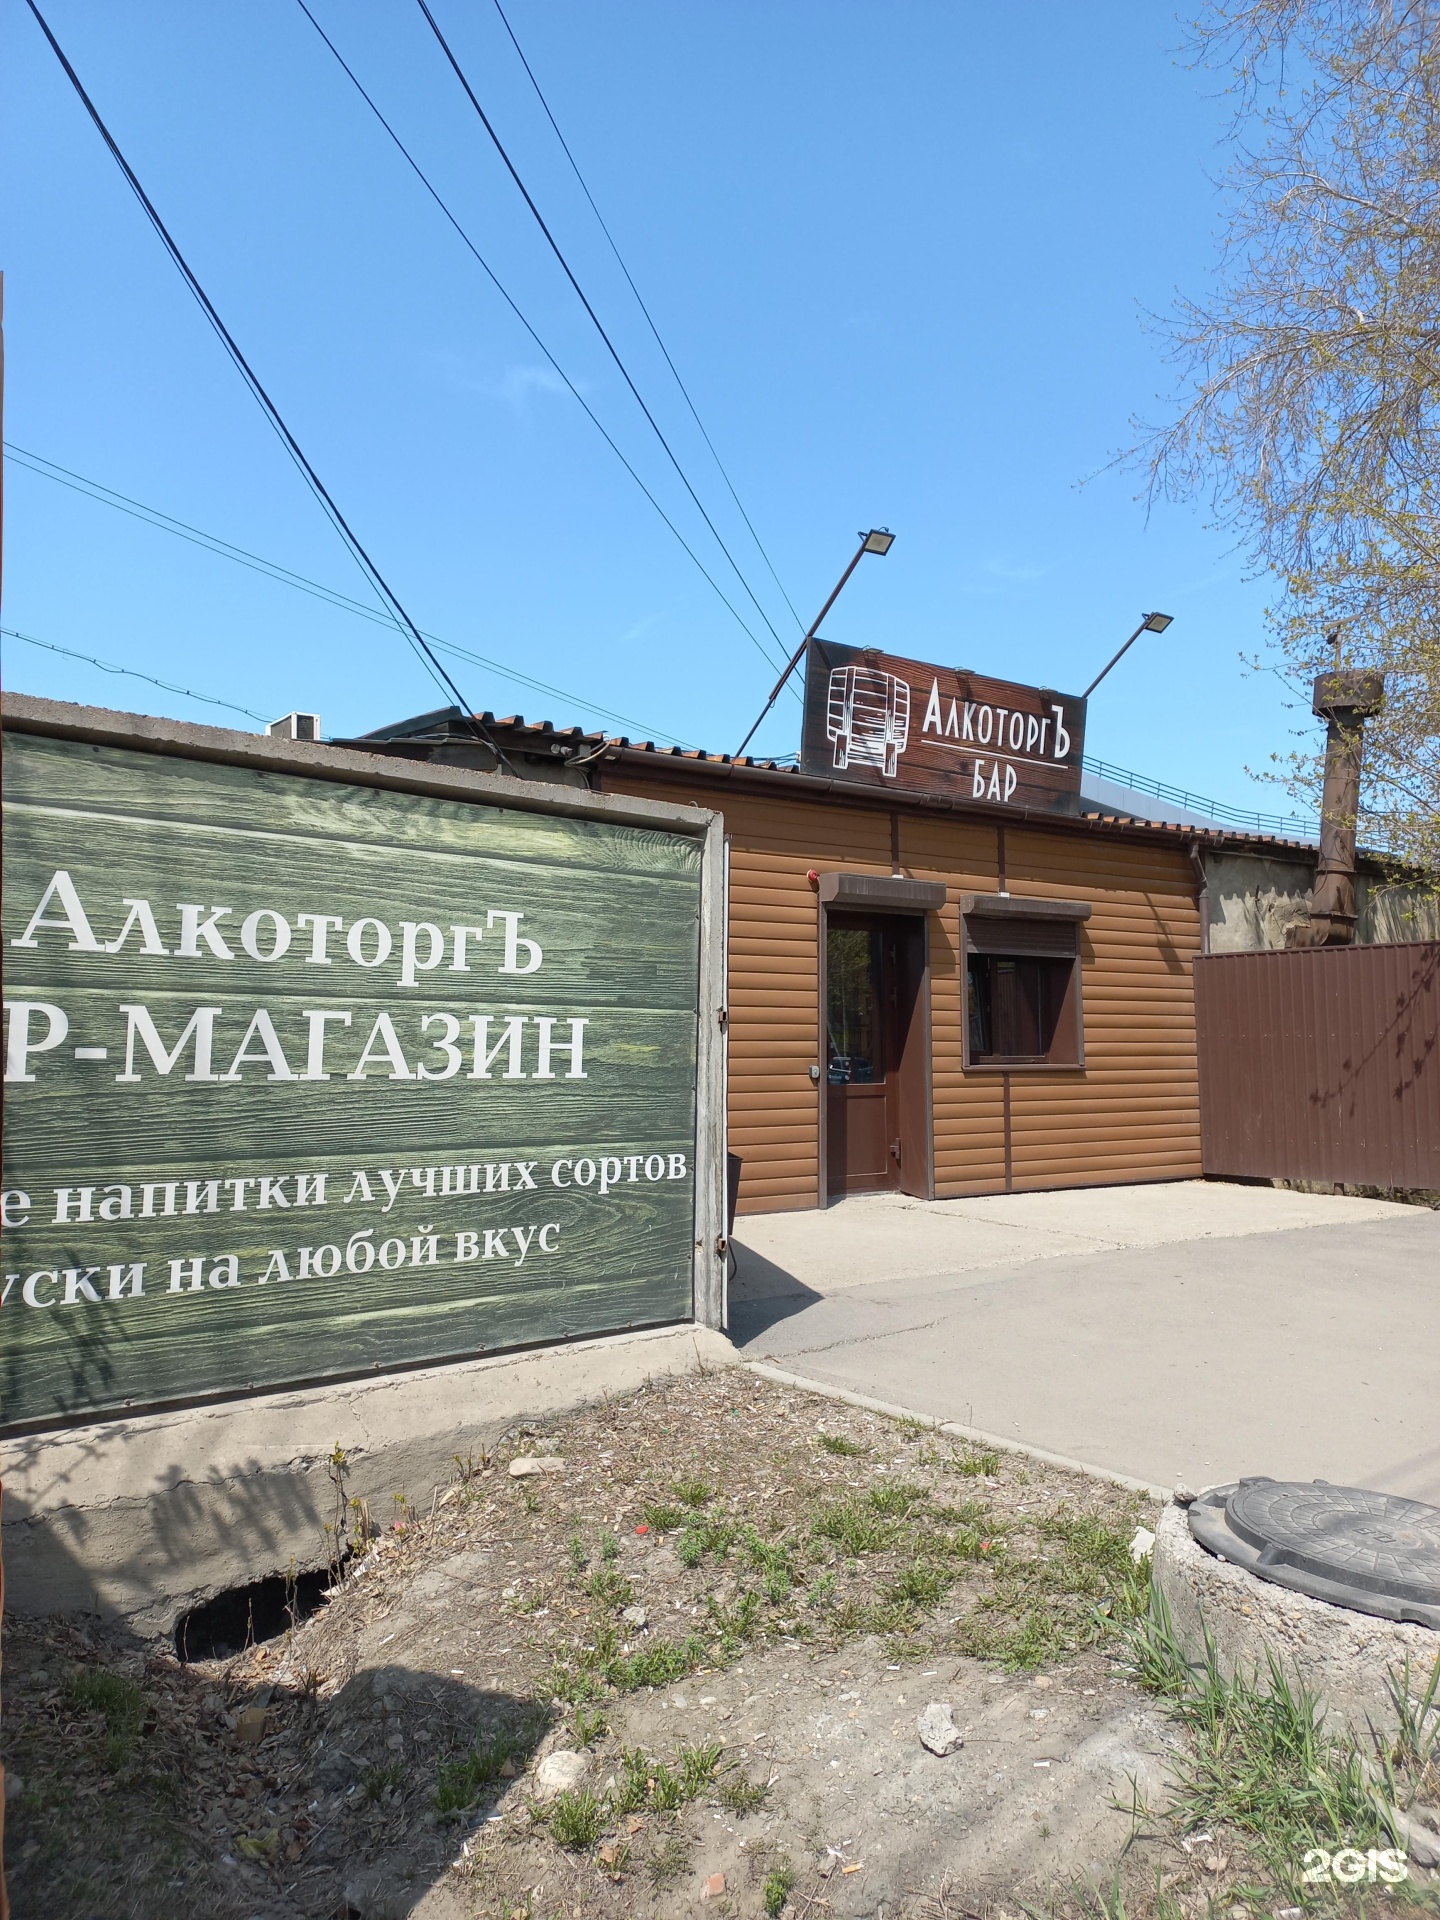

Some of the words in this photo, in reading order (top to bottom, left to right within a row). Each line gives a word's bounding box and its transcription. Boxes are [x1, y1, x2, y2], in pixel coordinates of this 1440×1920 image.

[972, 759, 1017, 802] БАР
[3, 1001, 590, 1082] Р-МАГАЗИН
[52, 1173, 327, 1224] напитки
[343, 1160, 537, 1213] лучших
[551, 1153, 687, 1195] сортов
[166, 1254, 241, 1293] на
[258, 1224, 438, 1284] любой
[453, 1222, 560, 1267] вкус
